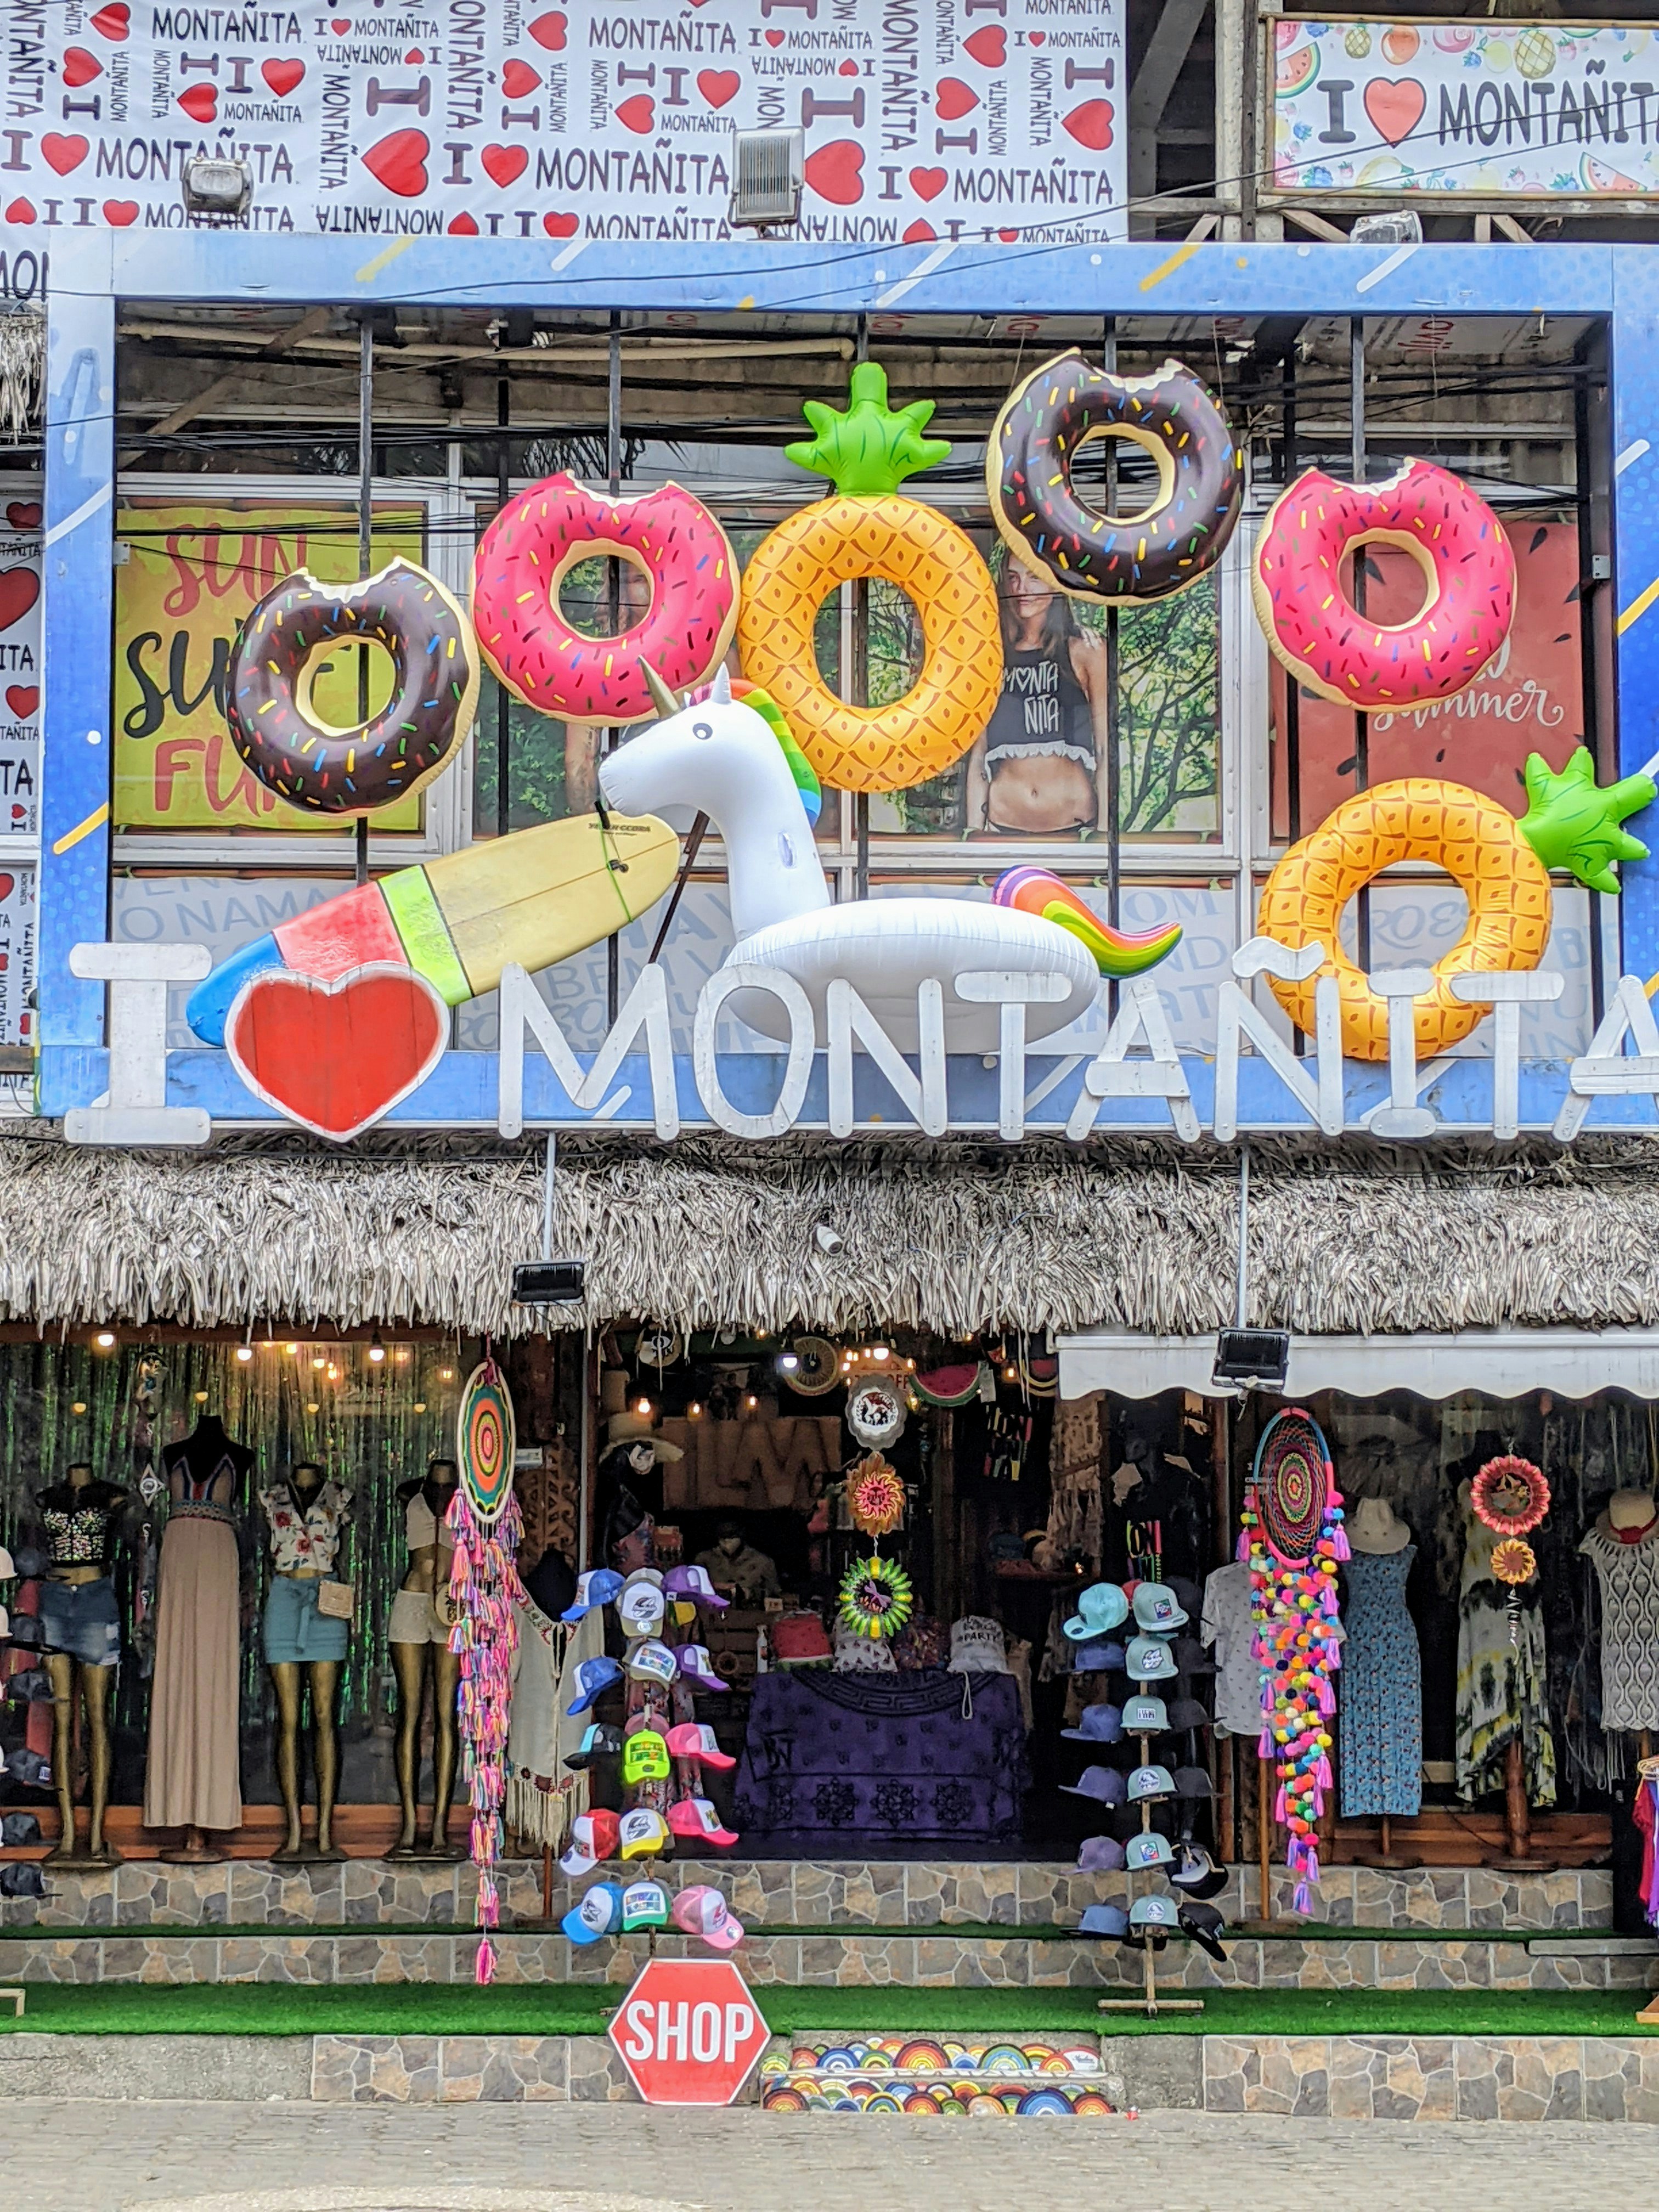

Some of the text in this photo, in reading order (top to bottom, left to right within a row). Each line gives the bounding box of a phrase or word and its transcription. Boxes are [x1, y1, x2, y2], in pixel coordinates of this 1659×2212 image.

[152, 1, 301, 43] MONTAÑITA
[314, 13, 439, 38] I MONTAÑITA
[589, 10, 736, 54] MONTAÑITA
[748, 25, 873, 50] I MONTAÑITA
[935, 0, 961, 65] ONTAÑITA
[1014, 26, 1121, 48] I MONTAÑITA
[6, 0, 57, 118] NTAÑITA
[105, 50, 130, 122] MONTAÑITA
[151, 49, 176, 119] MONTAÑITA
[225, 57, 254, 94] I
[446, 0, 497, 129] ONTAÑITA
[662, 67, 690, 105] I
[223, 99, 302, 123] MONTAÑITA
[545, 61, 568, 134] MONTAÑITA
[589, 59, 613, 130] MONTAÑITA
[661, 111, 737, 133] MONTAÑITA
[982, 80, 1008, 157] MONTAÑITA
[1029, 57, 1059, 146] MONTAÑITA
[1317, 59, 1659, 147] I MONTAÑIT
[2, 129, 33, 172] I
[319, 74, 358, 189] MONTAÑITA
[442, 137, 730, 195] I MONTAÑITA
[878, 156, 1114, 205] I MONTAÑITA
[64, 936, 1659, 1144] I MONTAÑITA
[625, 2000, 754, 2063] SHOP
